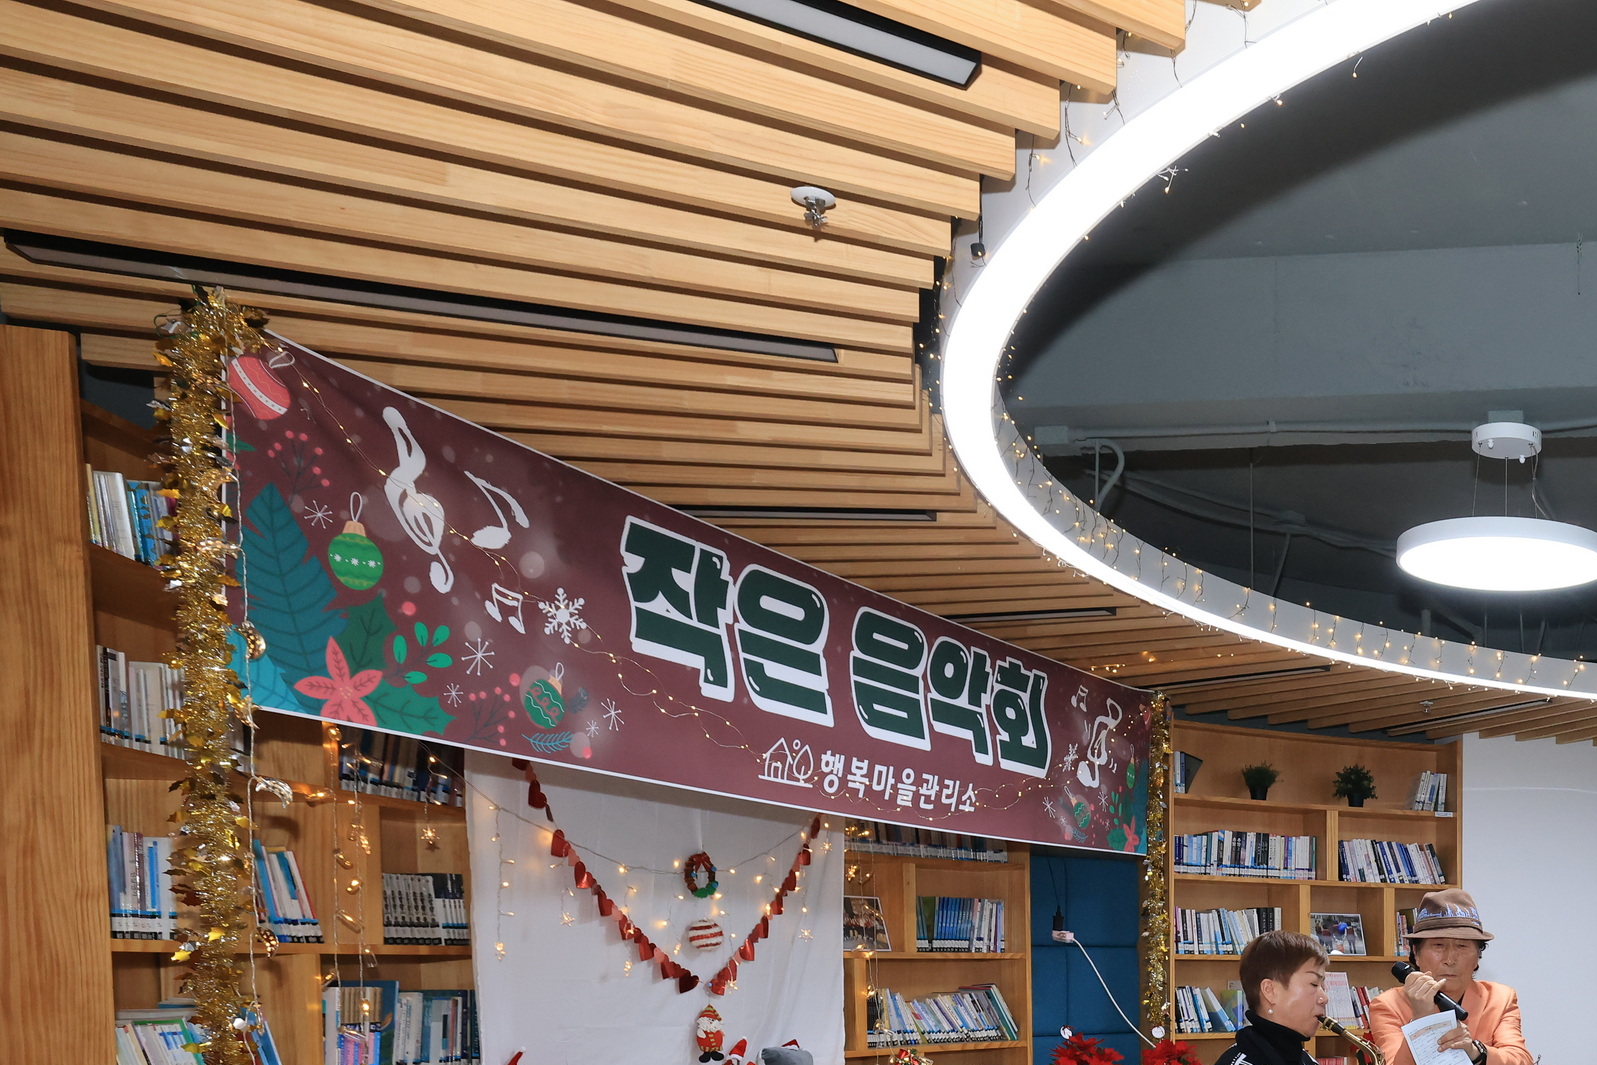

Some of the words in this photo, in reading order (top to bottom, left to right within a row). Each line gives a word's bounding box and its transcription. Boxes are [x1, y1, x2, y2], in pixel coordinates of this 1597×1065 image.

[620, 515, 834, 728] 작은
[850, 606, 1048, 778] 음악회
[820, 750, 976, 813] 행복마을관리소
